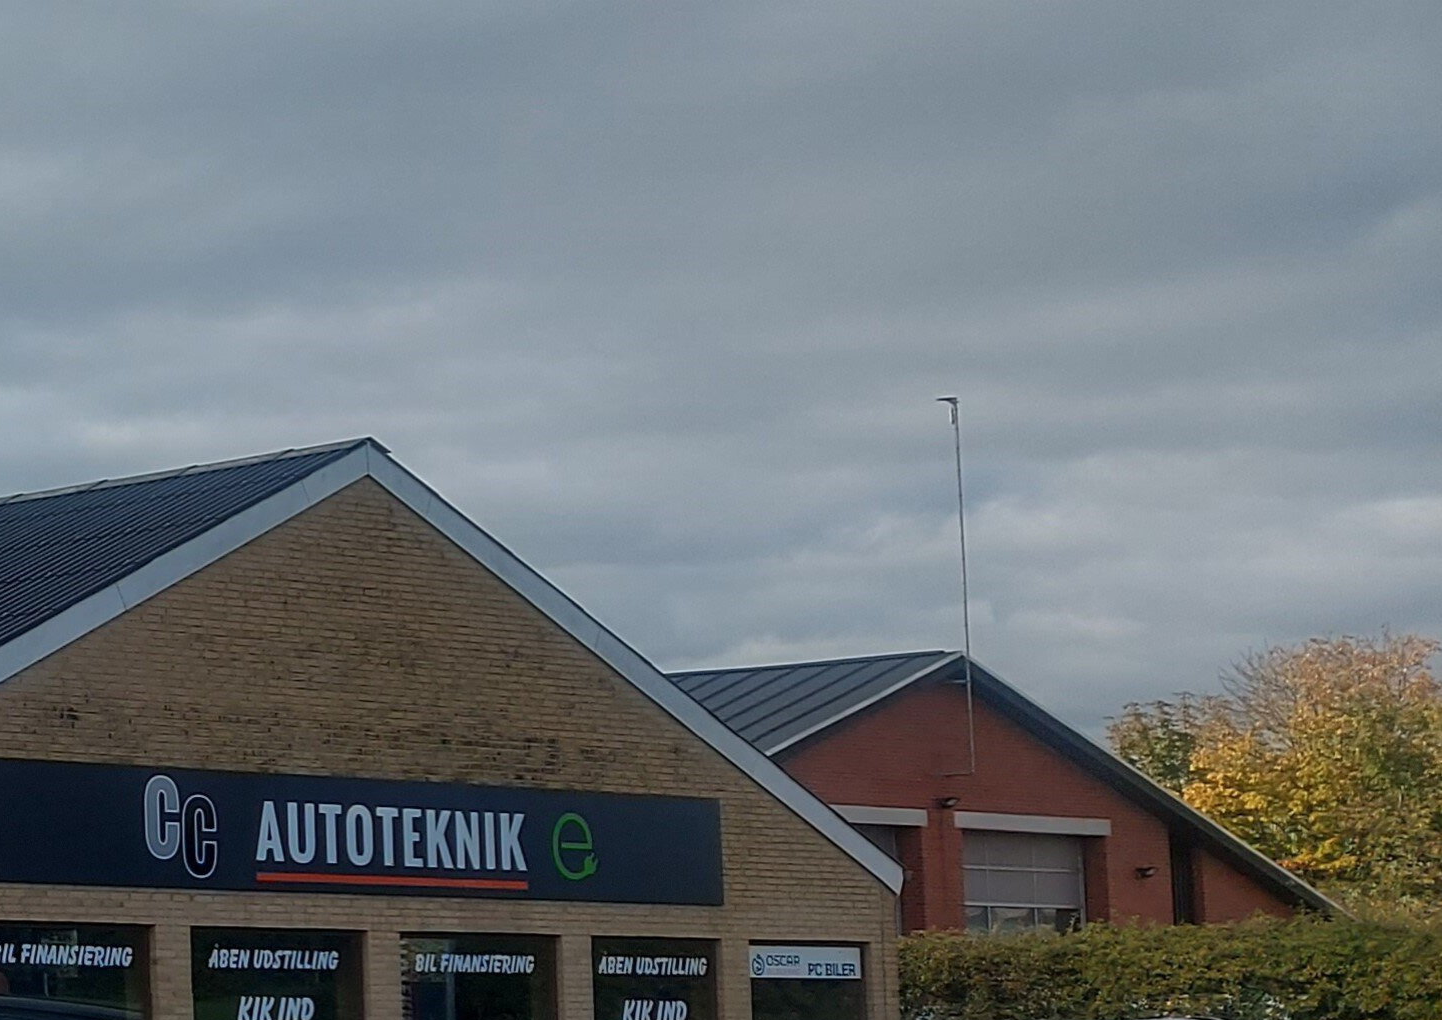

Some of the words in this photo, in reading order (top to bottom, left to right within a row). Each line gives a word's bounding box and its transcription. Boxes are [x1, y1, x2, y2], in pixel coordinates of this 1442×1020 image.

[256, 800, 528, 871] AUTOTEKNIK
[20, 944, 133, 967] FINANSIERING
[253, 949, 339, 970] UDSTILLING
[415, 954, 437, 972] BIL
[440, 953, 535, 974] FINANSIERING
[766, 955, 800, 966] OSCAR
[635, 957, 708, 976] UDSTILLING
[808, 963, 823, 976] PC
[825, 963, 856, 976] BILER
